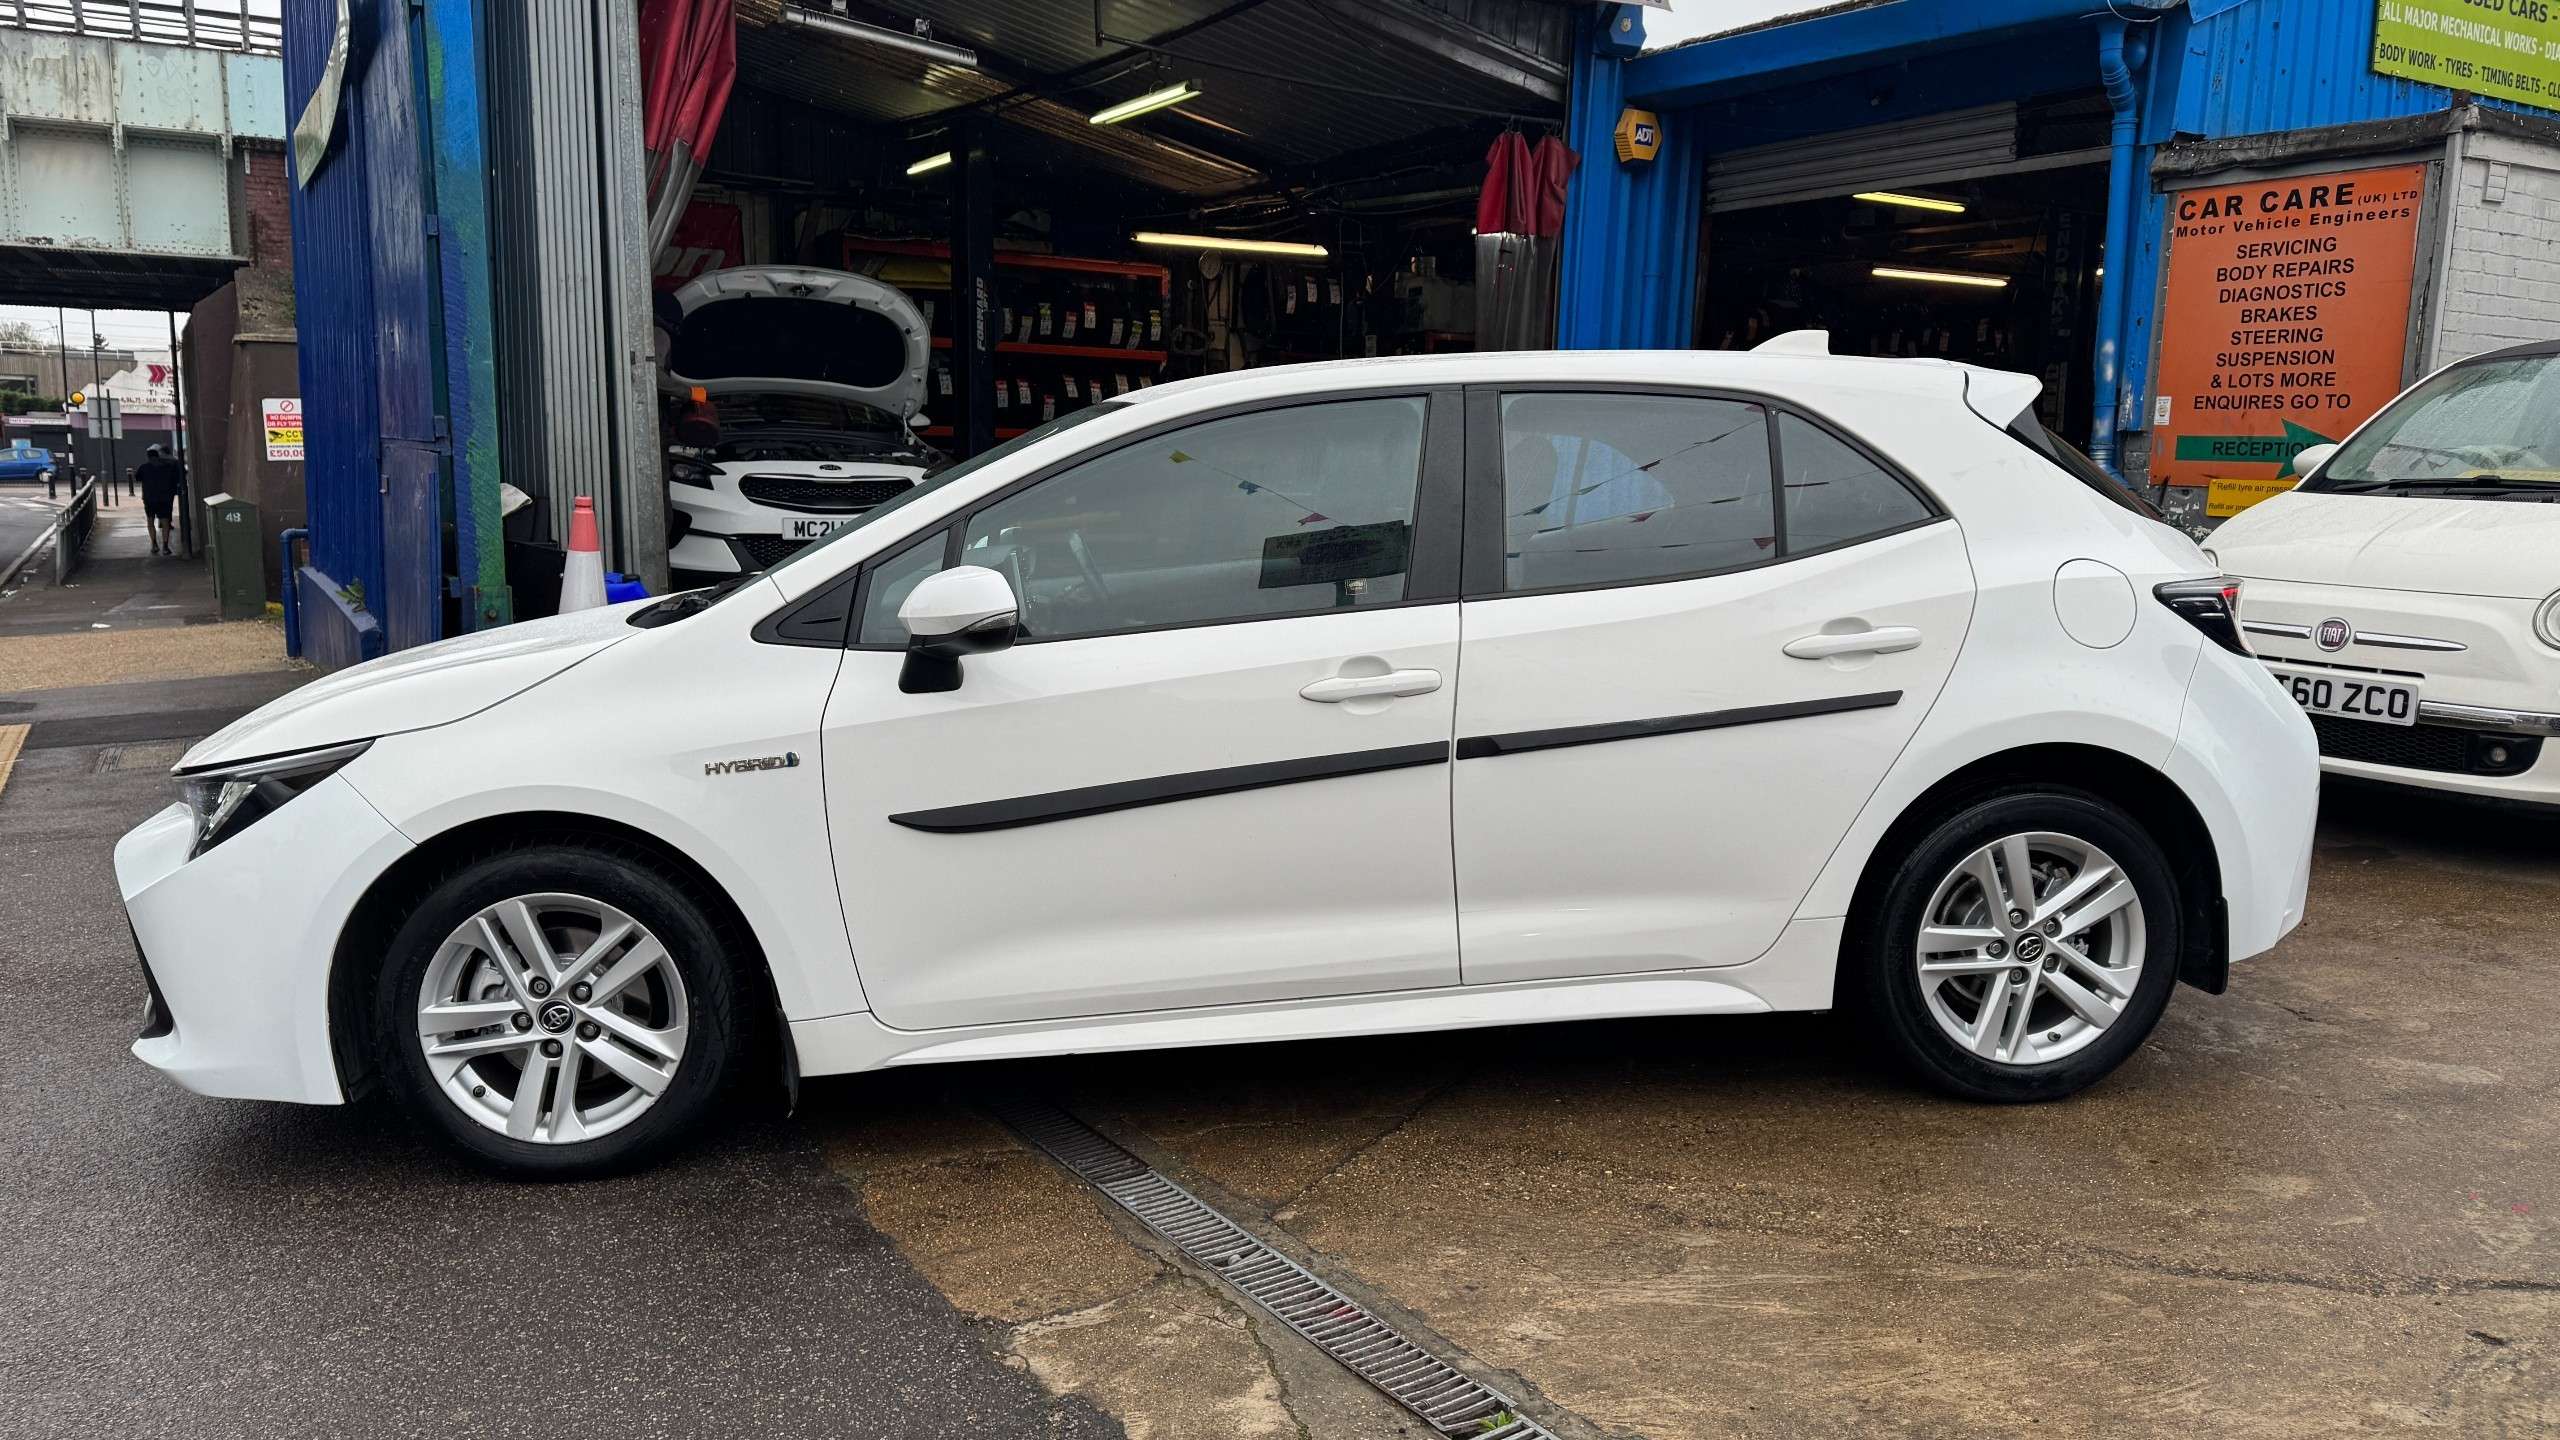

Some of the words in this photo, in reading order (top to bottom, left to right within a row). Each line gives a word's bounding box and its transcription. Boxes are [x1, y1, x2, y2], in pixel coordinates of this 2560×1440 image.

[2509, 0, 2548, 23] CARS
[2383, 2, 2401, 22] ALL
[2404, 6, 2438, 31] MAJOR
[2441, 15, 2501, 47] MECHANICAL
[2504, 31, 2537, 55] WORKS
[2380, 43, 2406, 63] BODY
[2408, 49, 2437, 70] WORK
[2446, 58, 2473, 78] TYRES
[2482, 66, 2514, 87] TIMING
[2515, 74, 2541, 93] BELTS
[1635, 127, 1654, 144] ADT
[2179, 195, 2243, 221] CAR
[2260, 183, 2355, 213] CARE
[2358, 193, 2387, 206] (UK)
[2393, 191, 2418, 200] LTD
[2176, 225, 2225, 238] Motor
[2233, 216, 2301, 232] Vehicle
[2310, 208, 2410, 226] Engineers
[2236, 236, 2337, 259] SERVICING
[2216, 264, 2267, 282] BODY
[2273, 258, 2354, 279] REPAIRS
[2219, 281, 2346, 304] DIAGNOSTICS
[976, 277, 986, 352] FORWARD
[2240, 305, 2318, 324] BRAKES
[2230, 327, 2324, 346] STEERING
[2216, 349, 2335, 367] SUSPENSION
[2210, 374, 2222, 388] &
[2228, 373, 2275, 388] LOTS
[2280, 371, 2337, 387] MORE
[2193, 394, 2285, 410] ENQUIRES
[2290, 394, 2319, 410] GO
[2326, 394, 2351, 409] TO
[2213, 441, 2311, 457] RECEPTIO
[2238, 483, 2253, 493] tyre
[2254, 484, 2264, 492] air
[224, 512, 241, 523] 48
[2322, 627, 2344, 643] FIAT
[2341, 682, 2410, 719] ZCO
[704, 756, 786, 776] HYBRID
